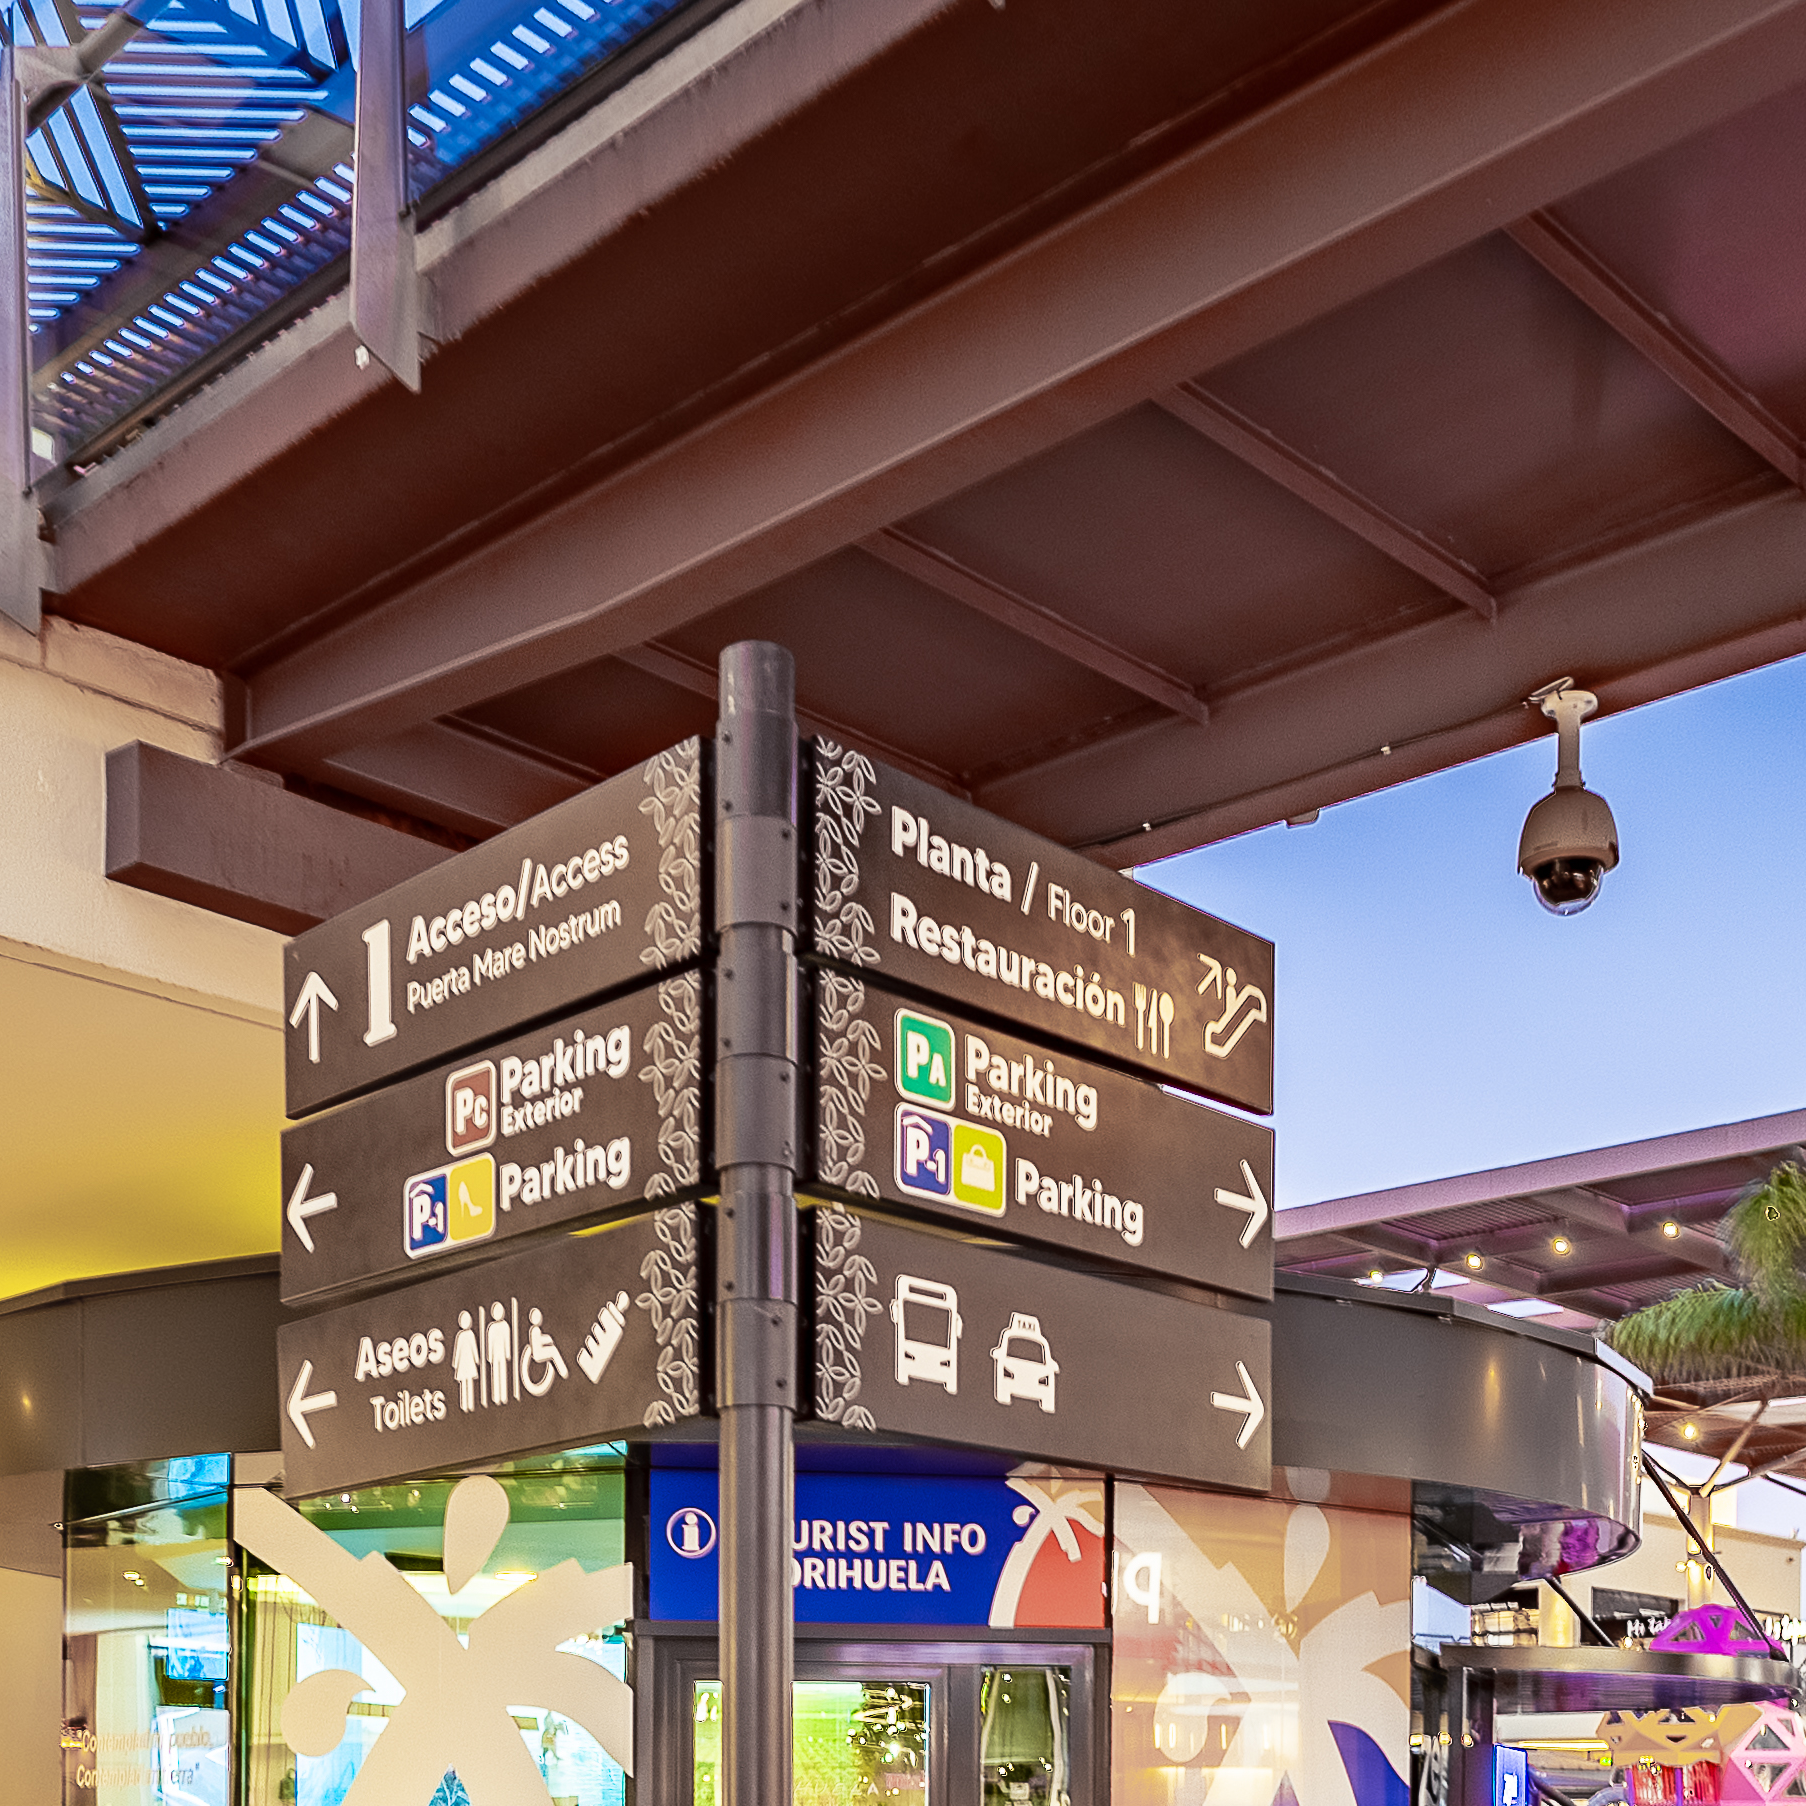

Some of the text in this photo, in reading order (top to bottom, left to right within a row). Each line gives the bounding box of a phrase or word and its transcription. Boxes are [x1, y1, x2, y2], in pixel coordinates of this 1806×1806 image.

[406, 835, 629, 964] Acceso/Access
[891, 805, 1011, 903] Planta
[1048, 882, 1115, 944] Floor
[1120, 908, 1136, 958] 1
[407, 900, 621, 1014] Puerta Mare Nostrum
[890, 892, 1126, 1028] Restauración
[500, 1025, 630, 1104] Parking
[965, 1033, 1097, 1131] Parking
[501, 1087, 583, 1137] Exterior
[965, 1083, 1053, 1138] Exterior
[500, 1137, 630, 1212] Parking
[1015, 1157, 1144, 1247] Parking
[355, 1327, 445, 1382] Aseos
[1017, 1320, 1036, 1332] TAXI
[370, 1389, 446, 1432] Toilets
[793, 1519, 988, 1555] URIST INFO
